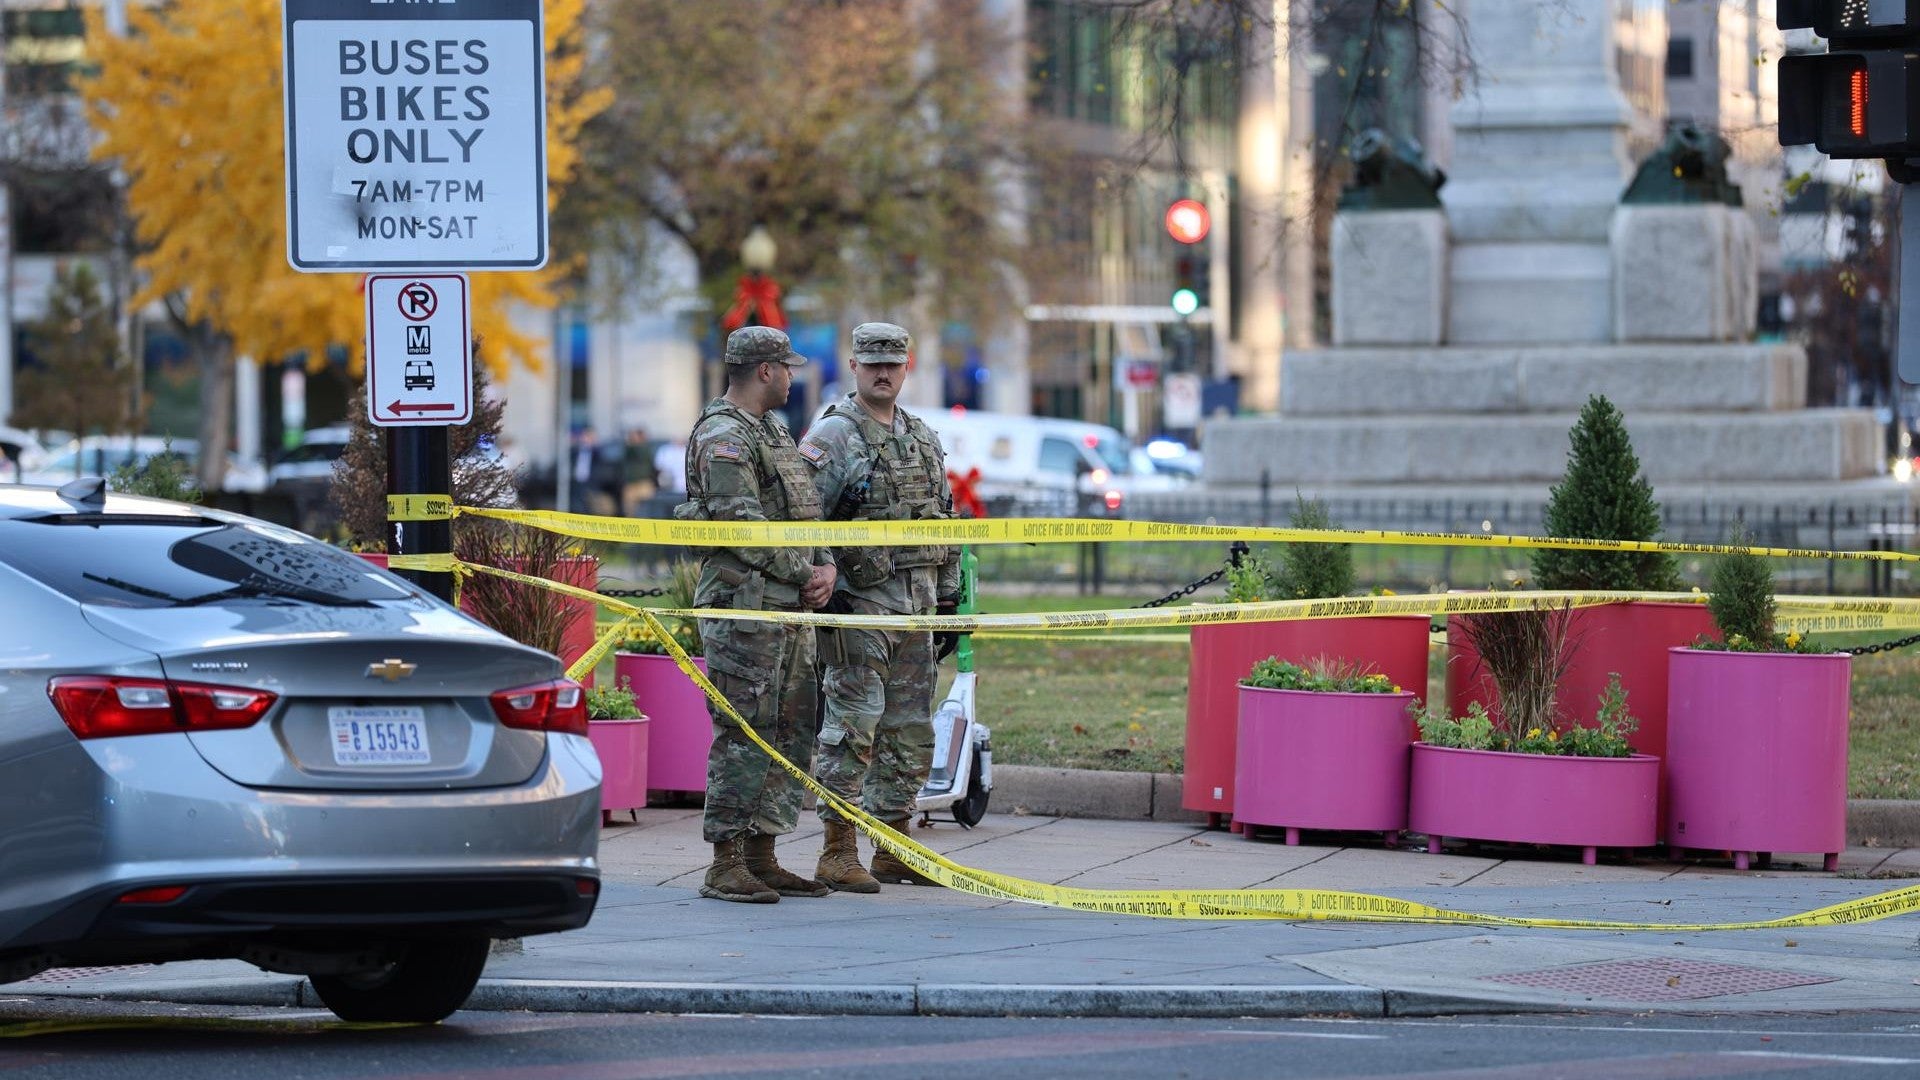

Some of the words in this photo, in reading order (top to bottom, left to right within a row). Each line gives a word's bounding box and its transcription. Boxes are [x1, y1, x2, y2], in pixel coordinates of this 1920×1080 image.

[339, 39, 489, 75] BUSES
[340, 86, 490, 121] BIKES
[347, 128, 484, 164] ONLY
[351, 179, 484, 203] 7AM-7PM
[358, 216, 478, 239] MON-SAT
[408, 327, 429, 348] M
[408, 346, 429, 354] metro
[365, 722, 420, 751] 15543
[907, 852, 930, 873] POLICE
[951, 874, 974, 892] CROSS
[976, 884, 990, 895] NOT
[1129, 902, 1145, 914] LINE
[1146, 902, 1172, 915] POLICE
[1829, 908, 1857, 924] CROSS
[1858, 906, 1875, 919] NOT
